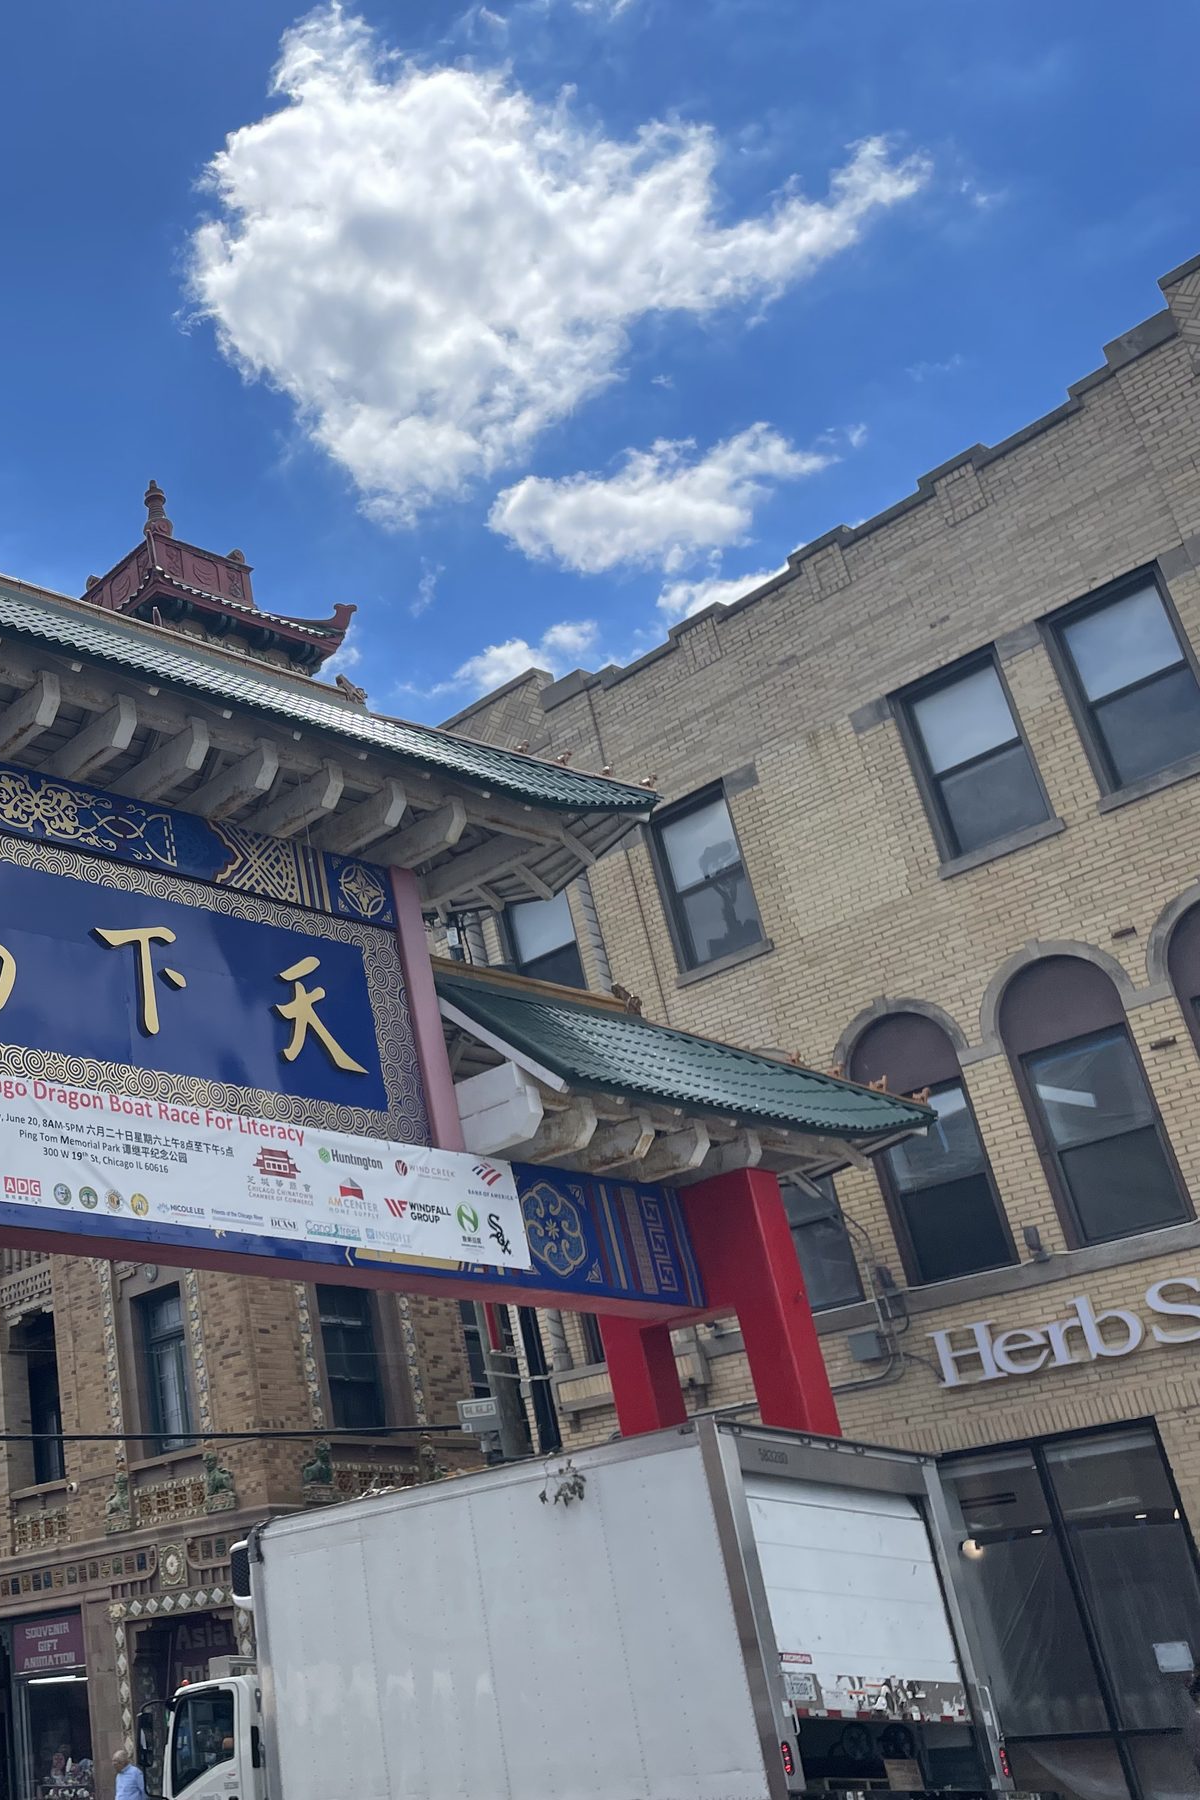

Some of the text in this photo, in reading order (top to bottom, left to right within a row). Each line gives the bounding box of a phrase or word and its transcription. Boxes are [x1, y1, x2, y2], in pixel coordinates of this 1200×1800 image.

[33, 1081, 103, 1111] Dragon
[109, 1094, 153, 1118] Boat
[157, 1103, 200, 1126] Race
[205, 1110, 232, 1131] For
[238, 1116, 304, 1146] Literacy
[6, 1113, 26, 1124] June
[28, 1116, 40, 1128] 20,
[42, 1119, 84, 1134] 8AM-5PM
[19, 1129, 120, 1153] Ping Tom Memorial Park
[43, 1147, 169, 1174] 300 W 19th St, Chicago IL 60616
[330, 1149, 383, 1171] Huntington
[5, 1177, 41, 1195] ADG
[409, 1202, 452, 1216] WINDFALL
[410, 1212, 440, 1224] GROUP
[25, 1622, 70, 1639] SOUVENIR
[38, 1639, 58, 1652] GIFT
[24, 1651, 75, 1669] ANIMATION
